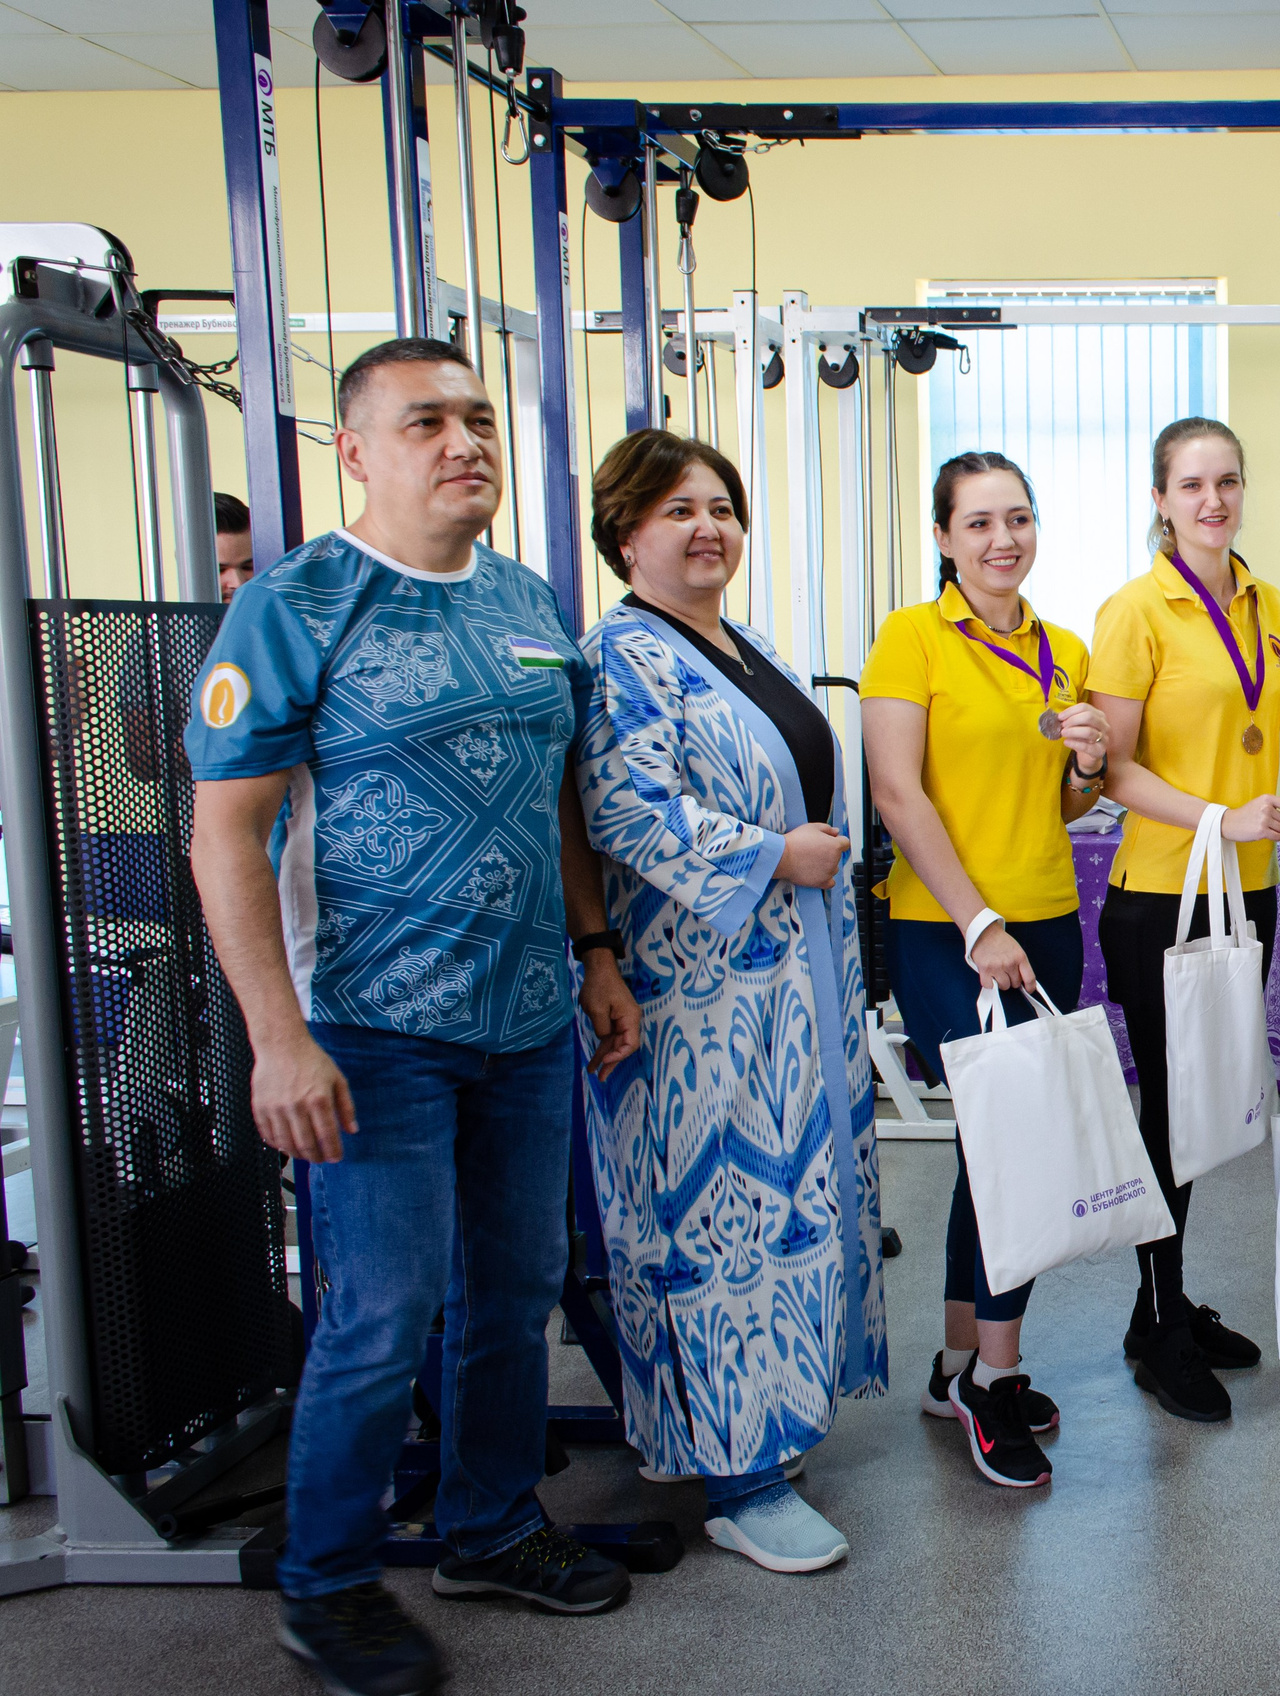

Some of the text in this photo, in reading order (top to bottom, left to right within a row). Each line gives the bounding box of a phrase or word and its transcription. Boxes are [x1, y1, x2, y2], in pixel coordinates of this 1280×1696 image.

[261, 101, 276, 157] МТБ
[159, 320, 200, 329] тренажер
[1090, 1177, 1144, 1203] ЦЕНТР ДОКТОРА
[1092, 1186, 1146, 1213] БУБНОВСКОГО
